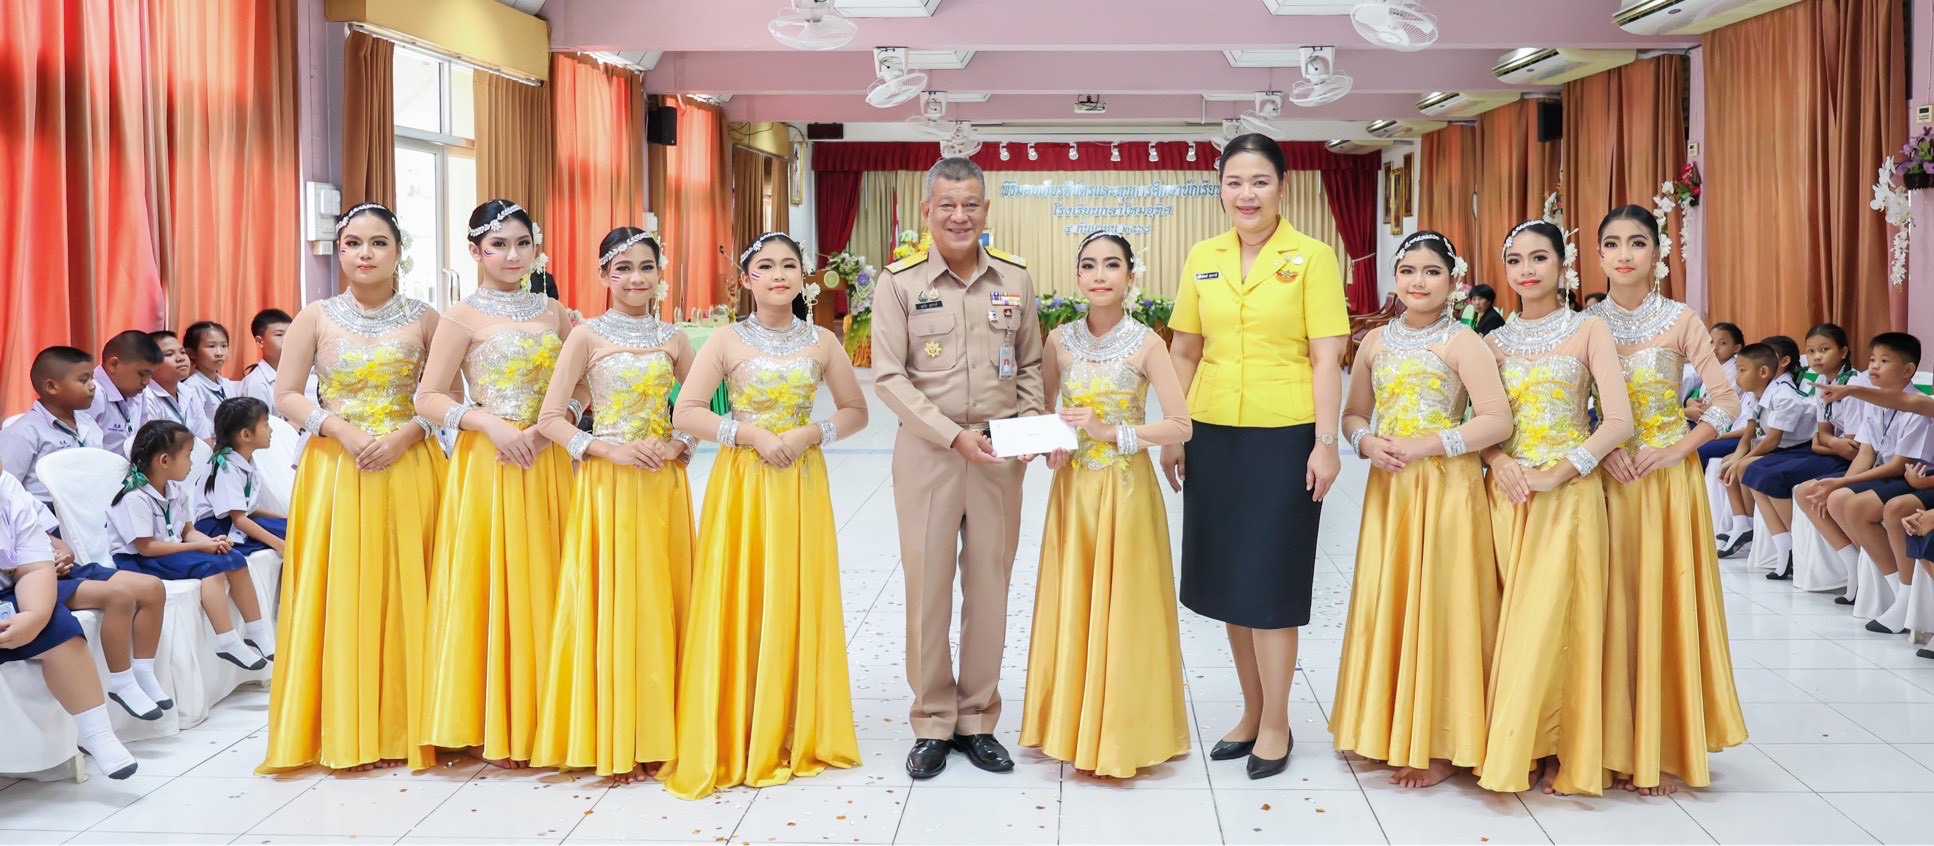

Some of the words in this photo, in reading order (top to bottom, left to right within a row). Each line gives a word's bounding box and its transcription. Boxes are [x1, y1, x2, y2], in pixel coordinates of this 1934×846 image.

[1053, 203, 1173, 220] โรงเรียนกลาโหมอุทิศ
